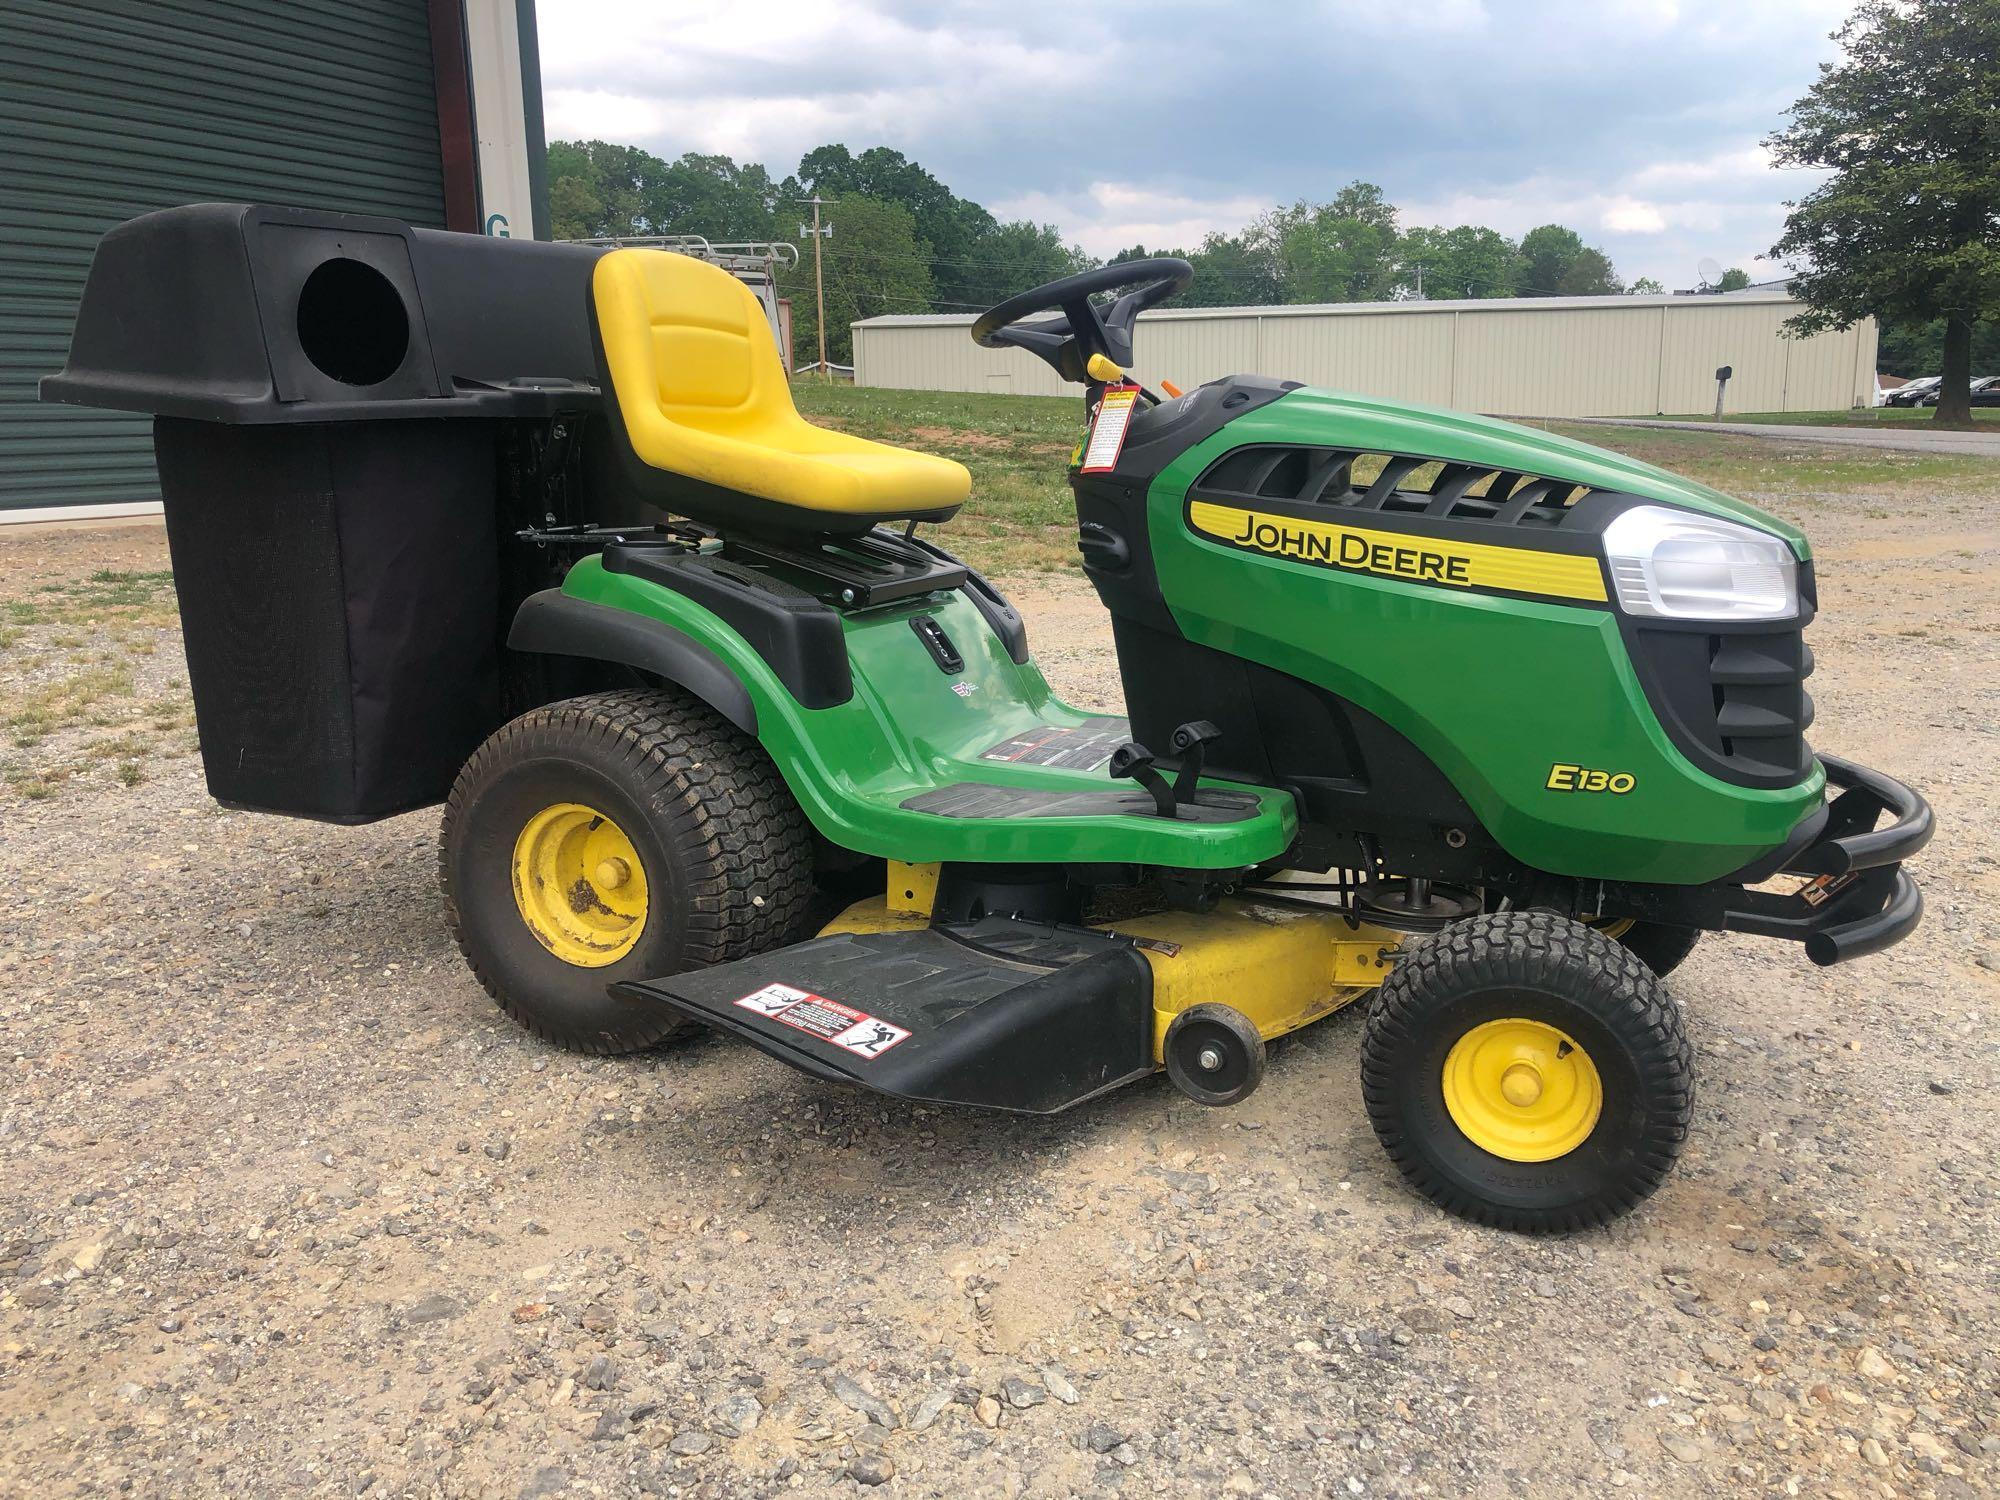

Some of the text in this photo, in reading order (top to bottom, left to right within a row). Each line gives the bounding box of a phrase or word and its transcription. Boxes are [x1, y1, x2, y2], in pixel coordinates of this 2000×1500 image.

[486, 213, 510, 238] G
[1234, 515, 1471, 583] JOHN DEERE
[1545, 763, 1636, 794] E130
[823, 1001, 860, 1017] DANGER
